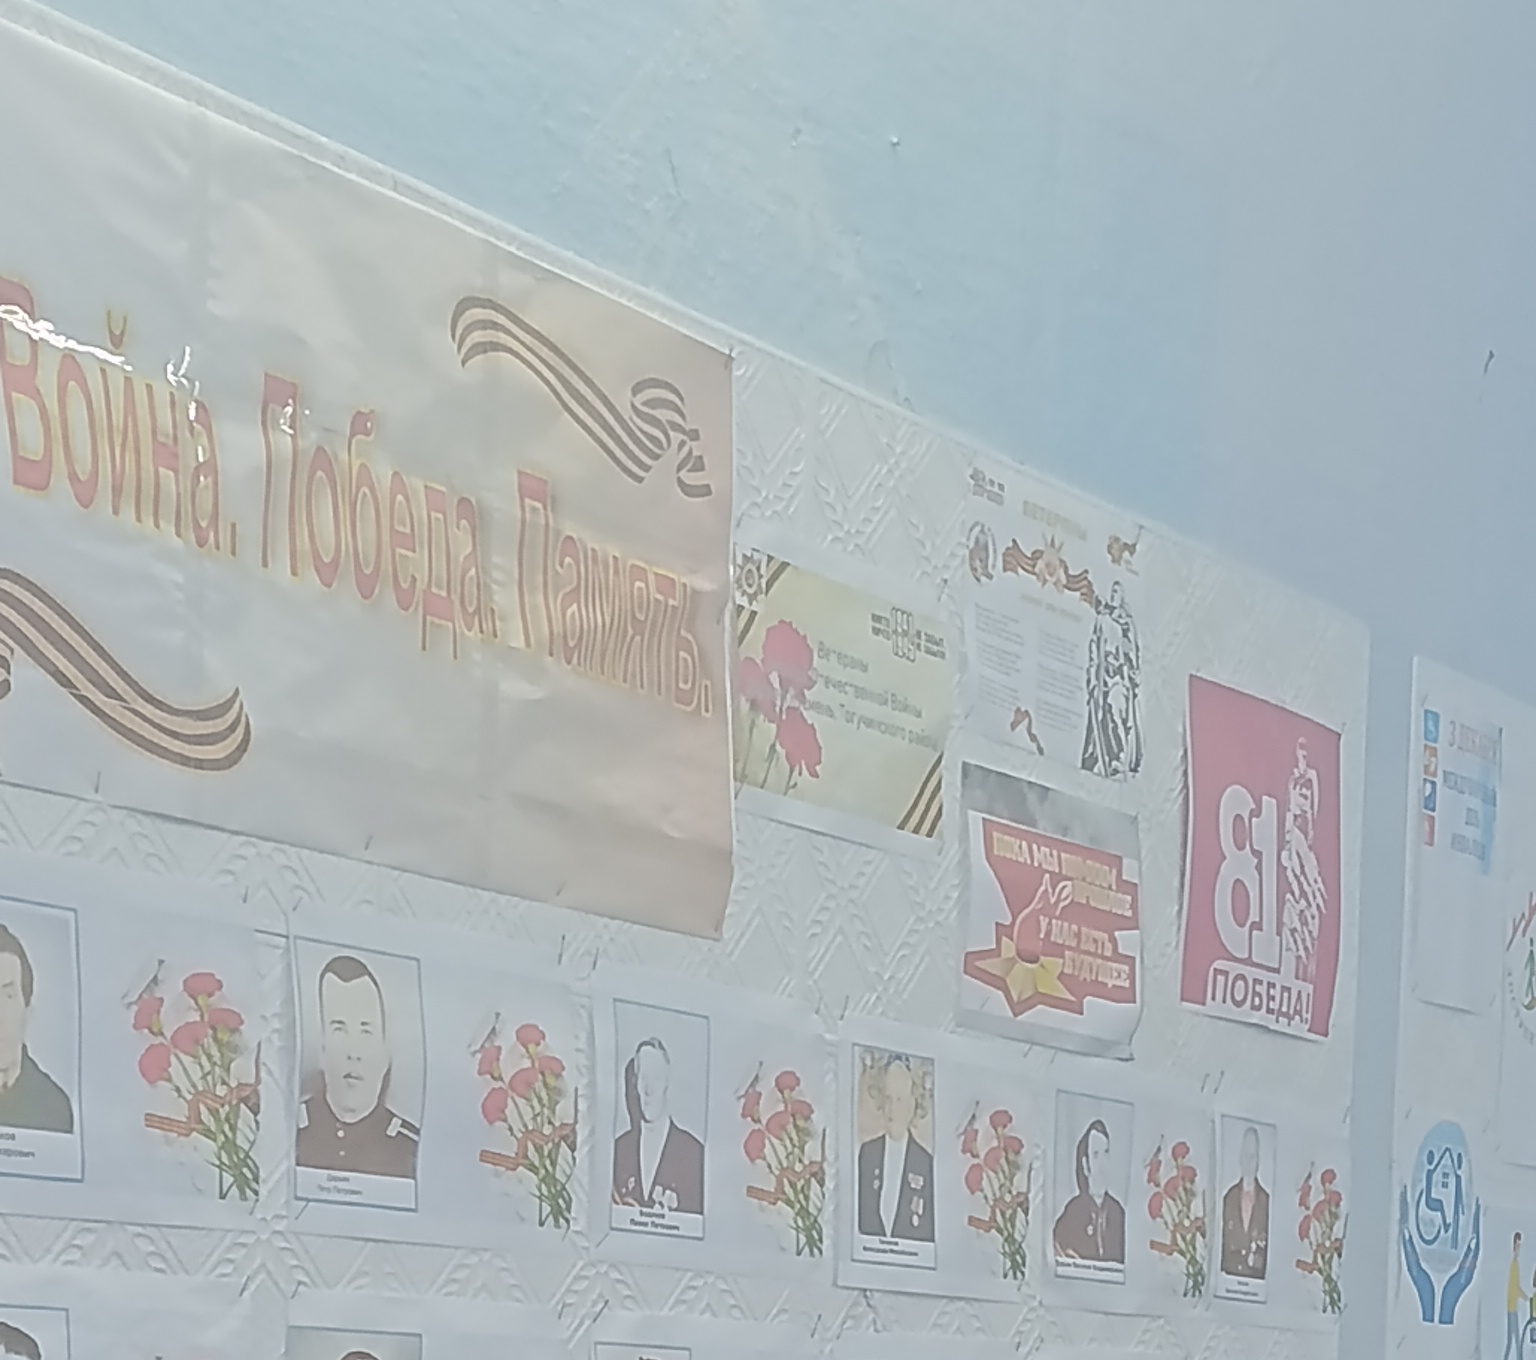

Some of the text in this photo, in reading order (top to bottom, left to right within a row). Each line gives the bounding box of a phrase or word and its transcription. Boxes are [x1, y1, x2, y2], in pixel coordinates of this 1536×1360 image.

[0, 276, 237, 558] Война.
[261, 371, 499, 660] Победа.
[516, 468, 714, 718] Память.
[1210, 967, 1310, 1027] ПОБЕДА!
